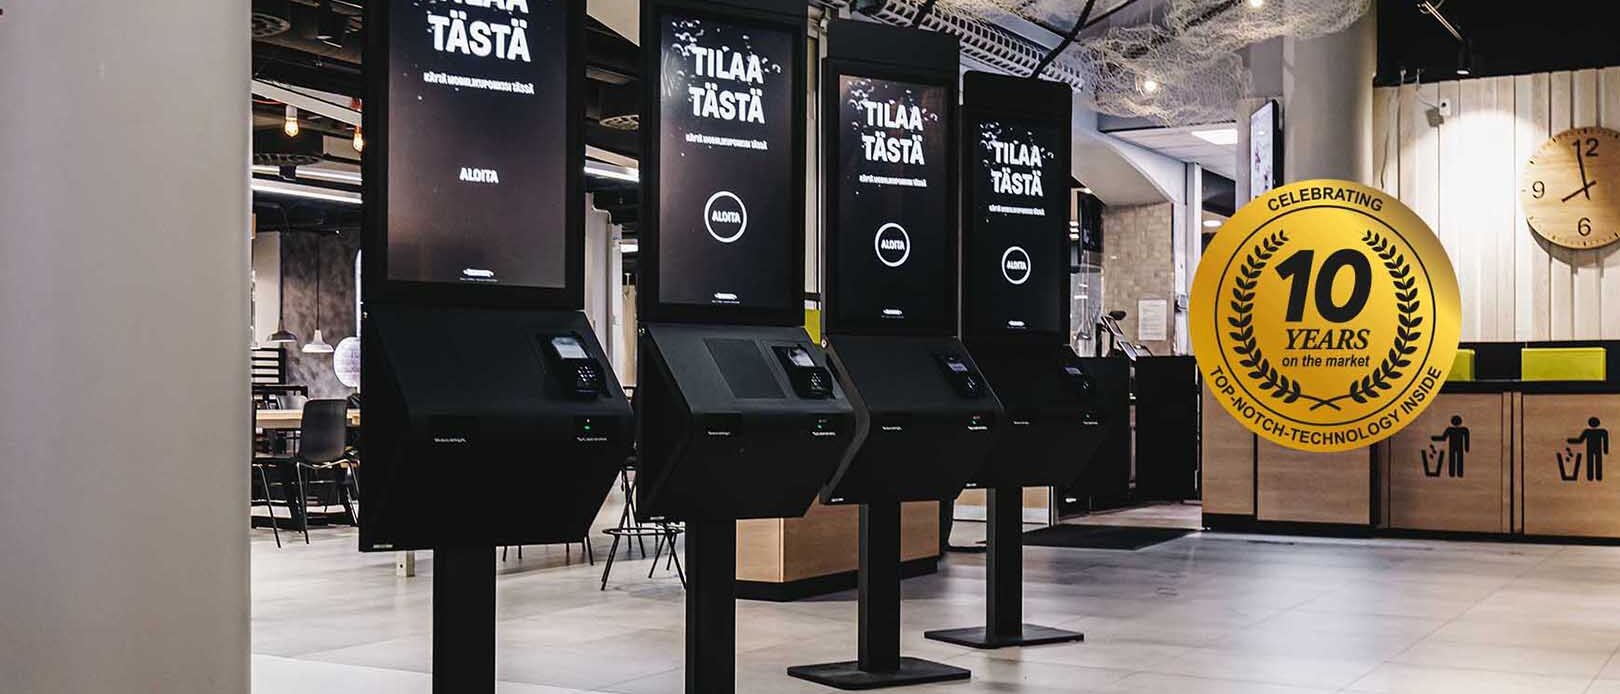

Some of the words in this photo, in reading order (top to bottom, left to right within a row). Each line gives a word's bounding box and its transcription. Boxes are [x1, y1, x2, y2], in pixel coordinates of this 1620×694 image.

[427, 9, 531, 62] TÄSTÄ
[692, 46, 764, 84] TILAA
[689, 82, 765, 124] TÄSTÄ
[863, 101, 924, 131] TILAA
[861, 131, 925, 165] TÄSTÄ
[992, 141, 1042, 168] TILAA
[459, 167, 499, 183] ALOITA
[991, 167, 1043, 197] TÄSTÄ
[1532, 180, 1545, 199] 9
[712, 210, 741, 224] ALOITA
[1577, 217, 1591, 237] 6
